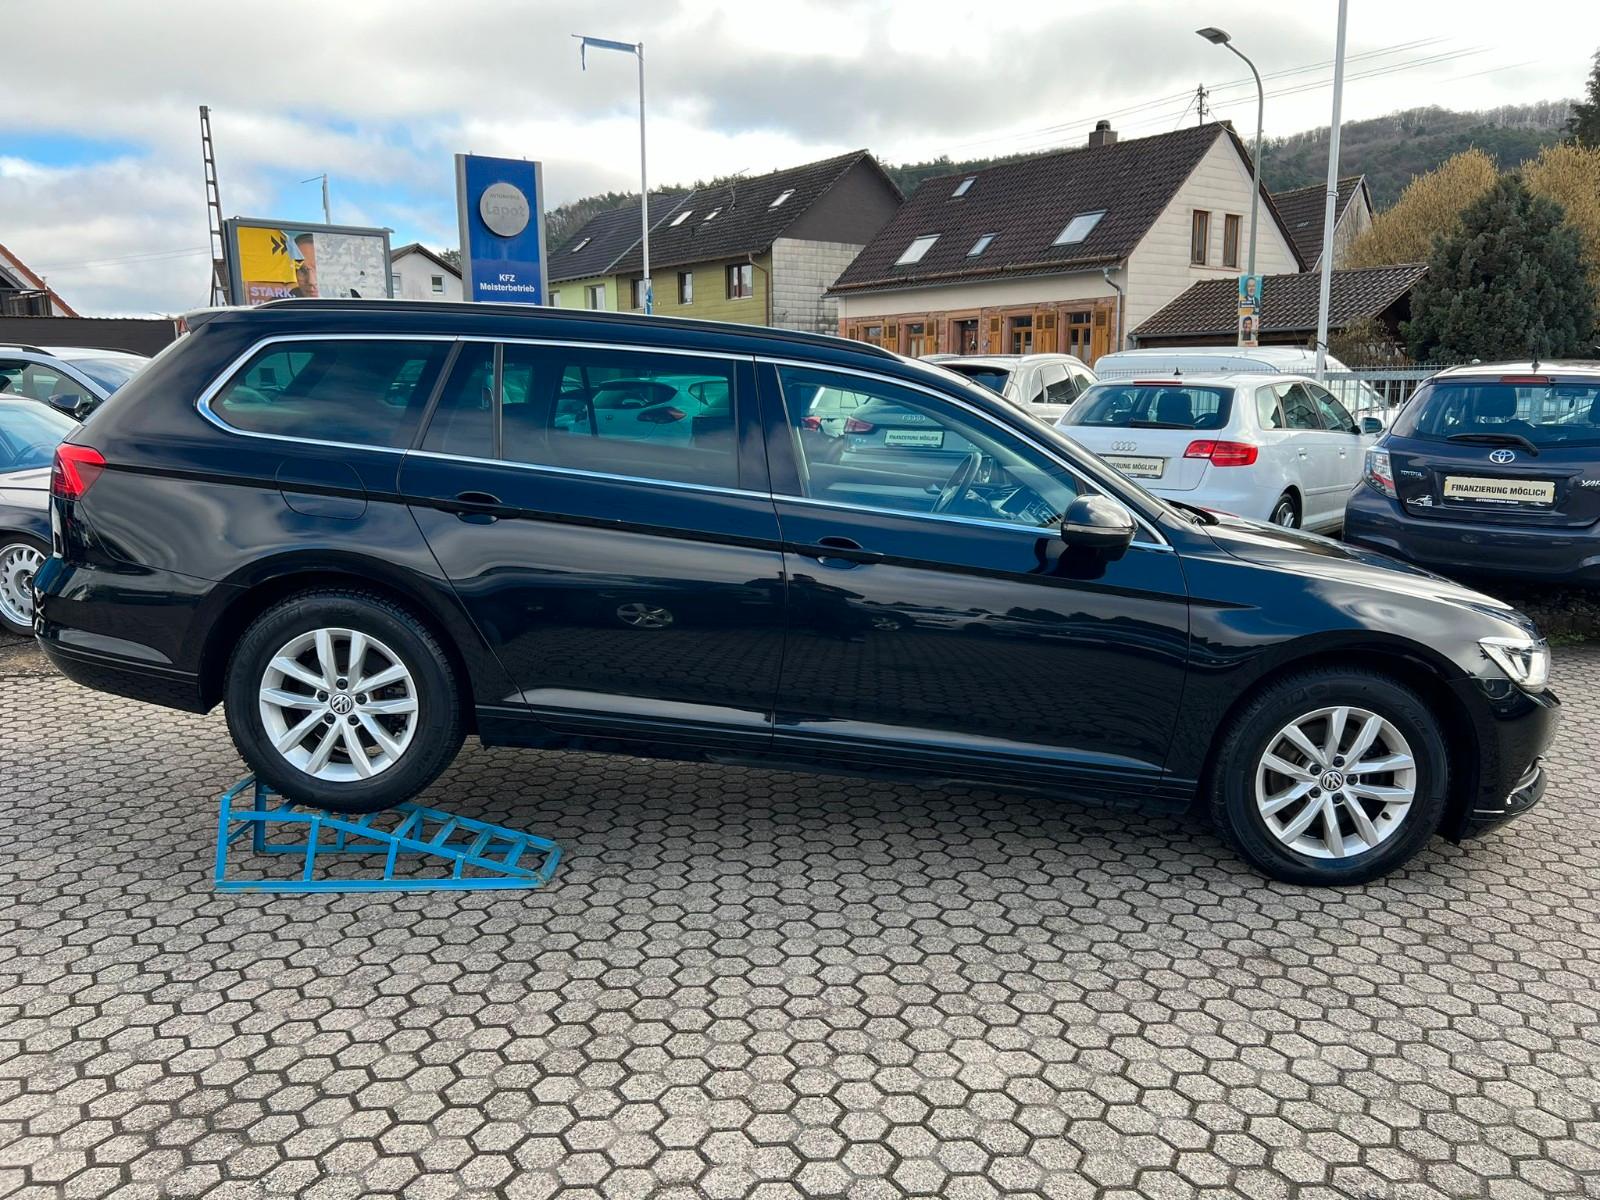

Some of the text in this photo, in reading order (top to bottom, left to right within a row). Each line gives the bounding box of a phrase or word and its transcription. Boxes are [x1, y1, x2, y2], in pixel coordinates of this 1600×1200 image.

[499, 274, 515, 282] KFZ
[480, 283, 535, 293] Meisterbetrieb
[1451, 483, 1547, 497] FINANZIERUNG MÖGLICH
